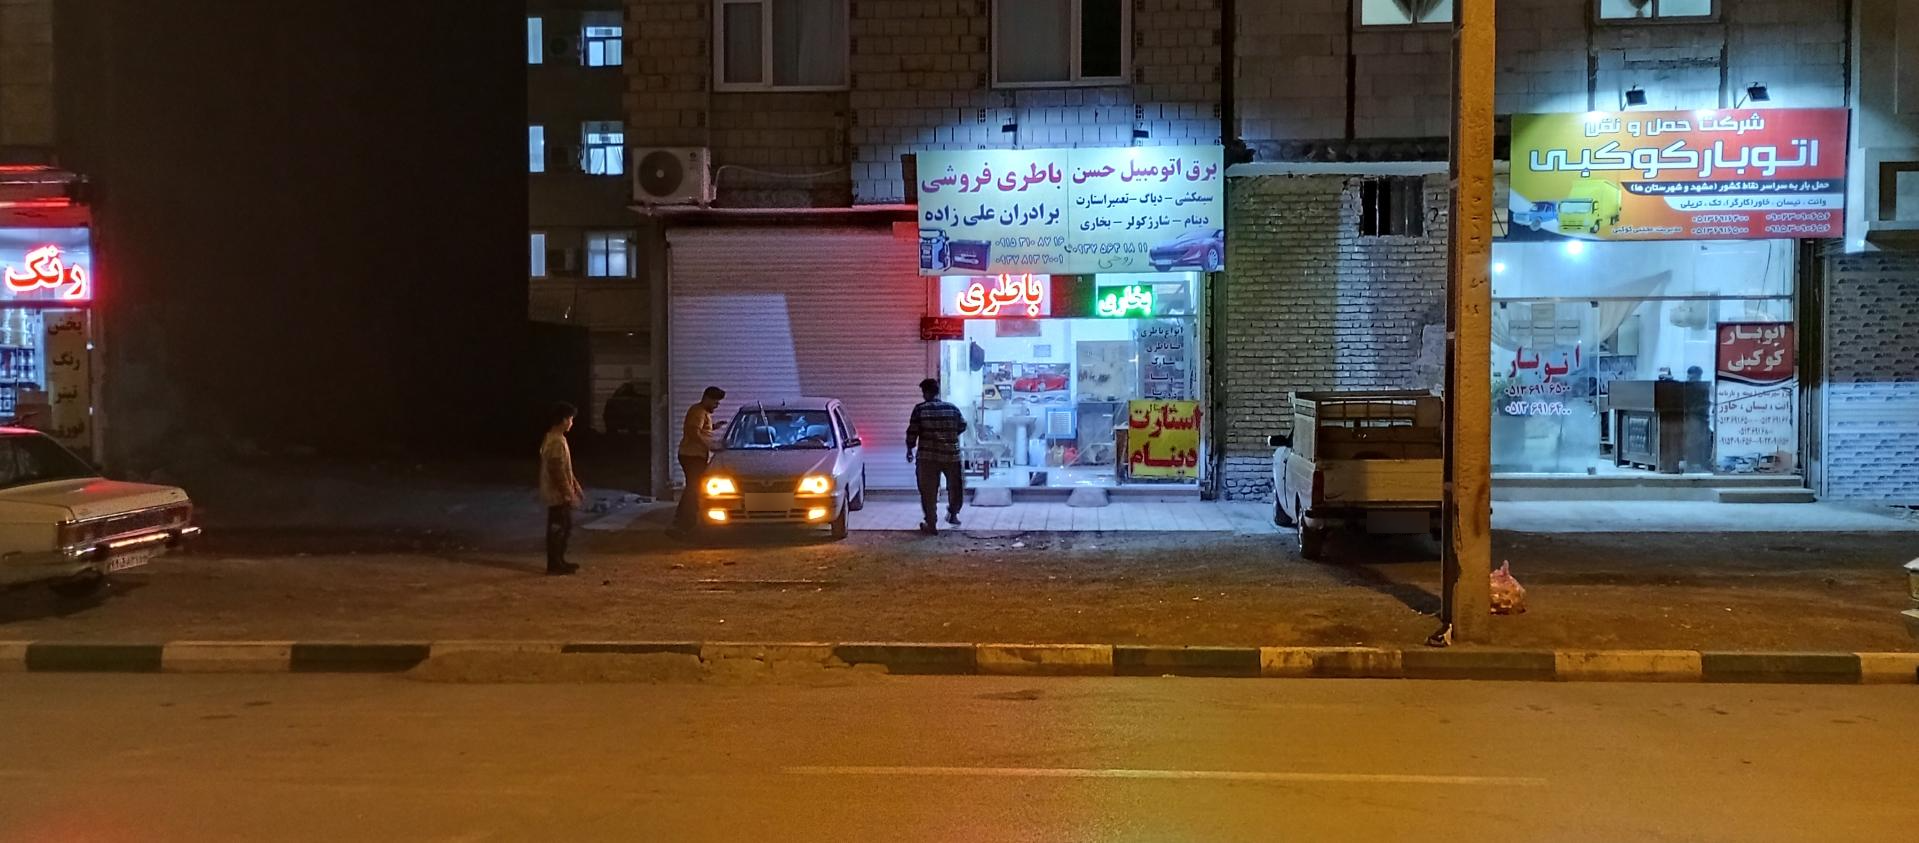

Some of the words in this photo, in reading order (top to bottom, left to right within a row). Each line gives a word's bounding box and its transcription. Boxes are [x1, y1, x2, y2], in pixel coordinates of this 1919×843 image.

[1585, 118, 1621, 137] نقل
[1627, 121, 1641, 137] و
[1646, 119, 1692, 136] حمل
[1700, 113, 1765, 135] شرکت
[922, 162, 992, 193] فروشی
[997, 162, 1063, 191] باطری
[1072, 165, 1116, 184] حسن
[1121, 158, 1182, 182] اتومبیل
[1186, 160, 1217, 182] برق
[1644, 183, 1683, 193] شهرستان
[1683, 184, 1689, 192] و
[1718, 182, 1741, 192] کشور
[1743, 182, 1759, 190] نقاط
[1760, 182, 1788, 192] سراسر
[1799, 181, 1811, 191] بار
[1811, 181, 1830, 191] حمل
[1175, 192, 1214, 206] سیمکشی
[1776, 198, 1801, 207] نیسان
[925, 205, 959, 227] زاده
[963, 203, 995, 226] علی
[1000, 203, 1060, 225] برادران
[1185, 215, 1209, 228] دینام
[1080, 216, 1111, 231] بخاری
[1138, 242, 1148, 253] ۱۱
[956, 273, 1044, 317] باطری
[1098, 285, 1152, 317] بخاری
[1504, 384, 1527, 396] ۰۵۱۳
[1529, 384, 1545, 396] ۶۹۱
[1550, 383, 1571, 395] ۶۵۰۰
[1505, 401, 1528, 415] ۰۵۱۳
[1129, 404, 1203, 438] استارت
[1129, 441, 1198, 475] دینام
